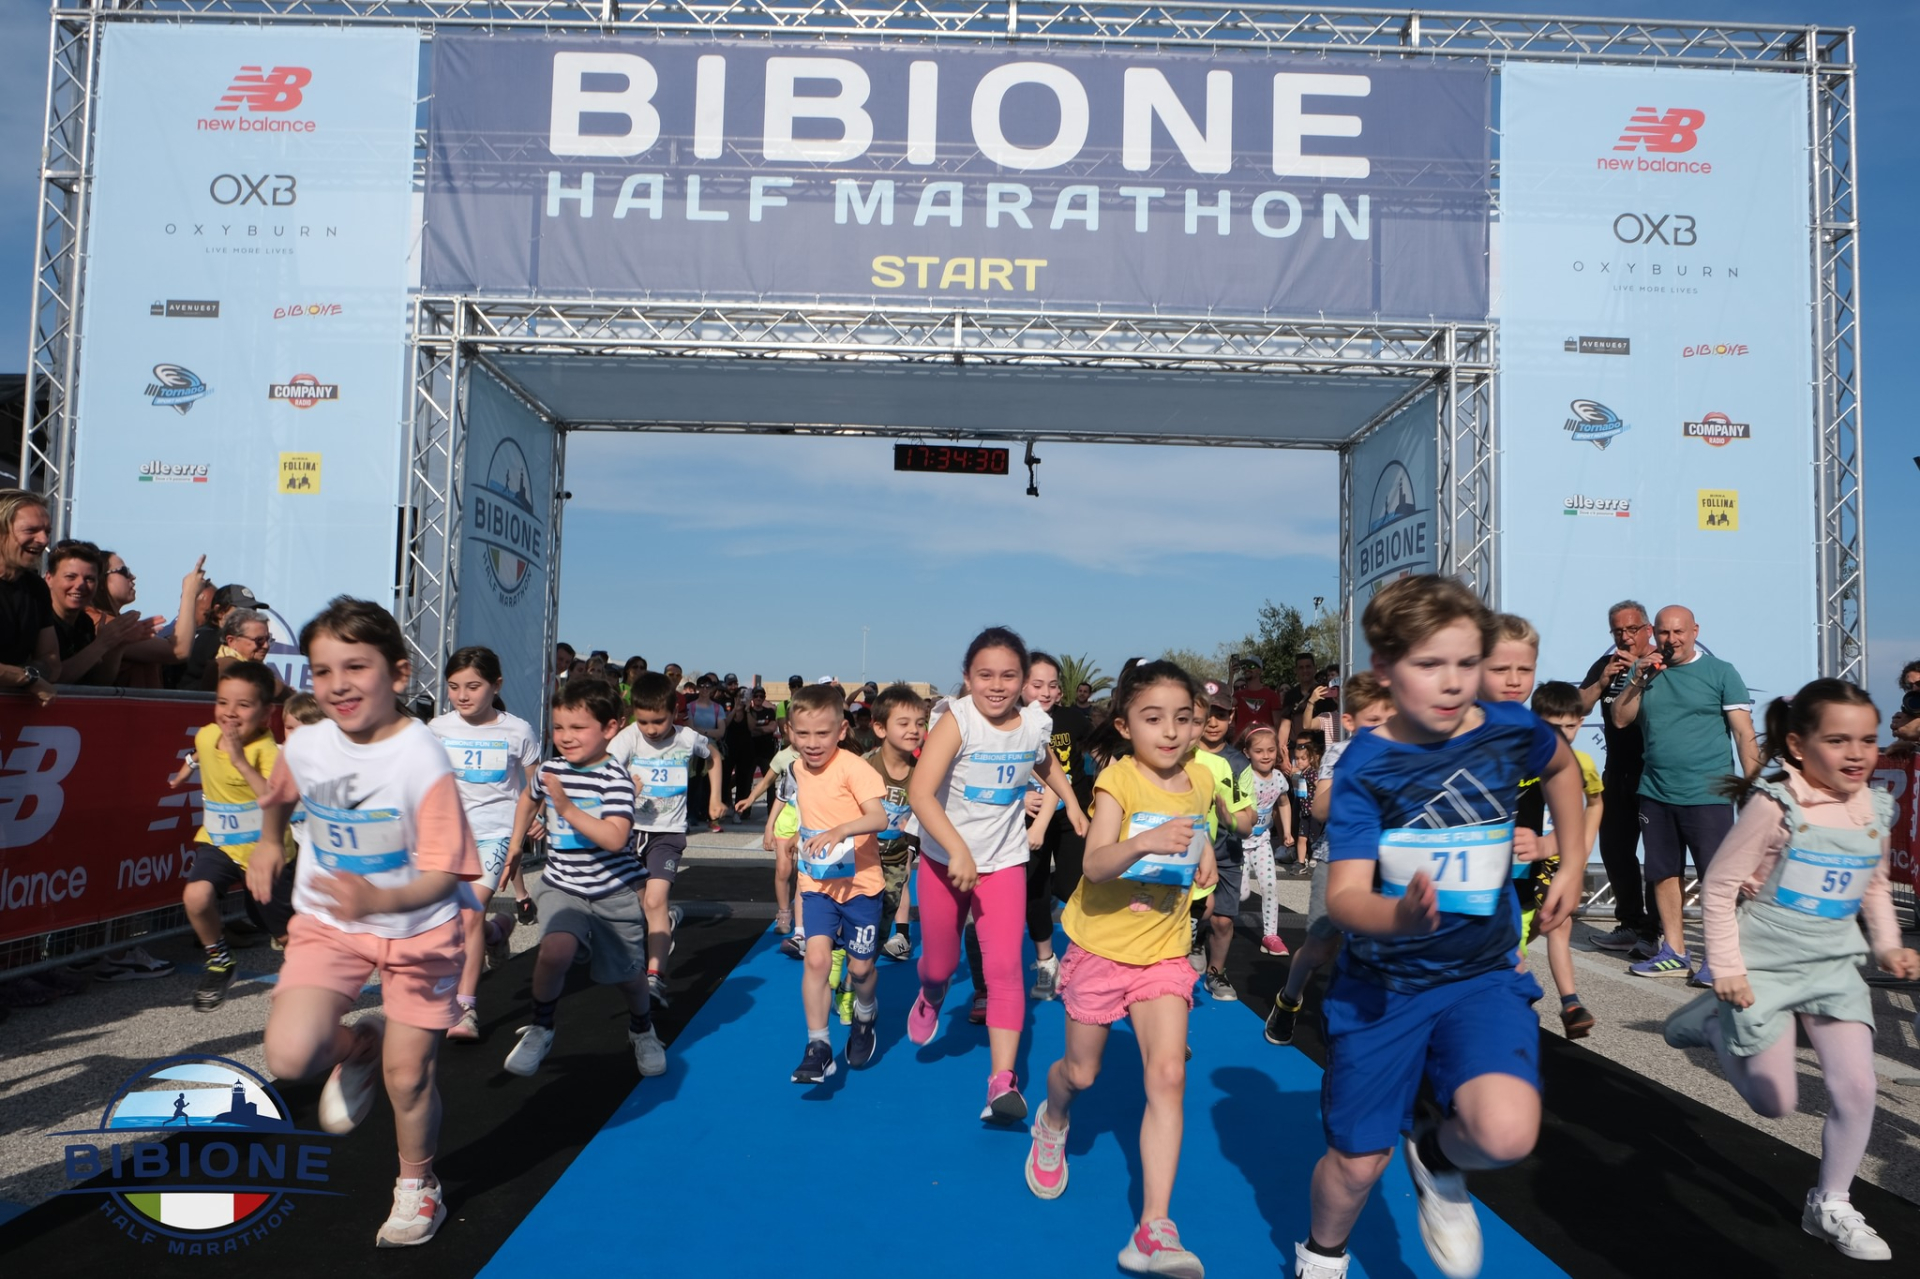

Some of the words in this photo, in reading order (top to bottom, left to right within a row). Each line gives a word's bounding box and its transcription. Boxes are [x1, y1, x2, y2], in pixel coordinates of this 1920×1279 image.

[197, 119, 236, 131] new
[239, 116, 316, 132] balance
[549, 52, 1372, 179] BIBIONE
[1597, 157, 1634, 170] new
[1637, 156, 1712, 174] balance
[210, 174, 296, 206] OXB
[545, 171, 794, 222] HALF
[834, 179, 1371, 241] MARATHON
[165, 223, 337, 237] OXYBURN
[1613, 213, 1697, 246] OXB
[233, 247, 261, 255] MORE
[872, 255, 1048, 291] START
[1573, 260, 1738, 278] OXYBURN
[169, 304, 217, 312] AVENUE67
[273, 303, 343, 319] BIBIONE
[1582, 341, 1627, 349] AVENUE67
[1682, 344, 1749, 358] BIBIONE
[274, 386, 333, 398] COMPANY
[1688, 423, 1745, 437] COMPANY
[284, 461, 316, 471] FOLLINA
[906, 447, 1006, 472] 17:34:30
[1702, 498, 1734, 508] FOLLINA
[474, 497, 542, 559] BIBIONE
[1360, 522, 1426, 577] BIBIONE
[464, 750, 482, 766] 21
[651, 768, 668, 782] 23
[997, 765, 1016, 784] 19
[218, 814, 239, 830] 70
[327, 823, 359, 850] 51
[117, 853, 173, 890] new
[1431, 850, 1469, 882] 71
[1821, 869, 1852, 894] 59
[855, 924, 876, 945] 10
